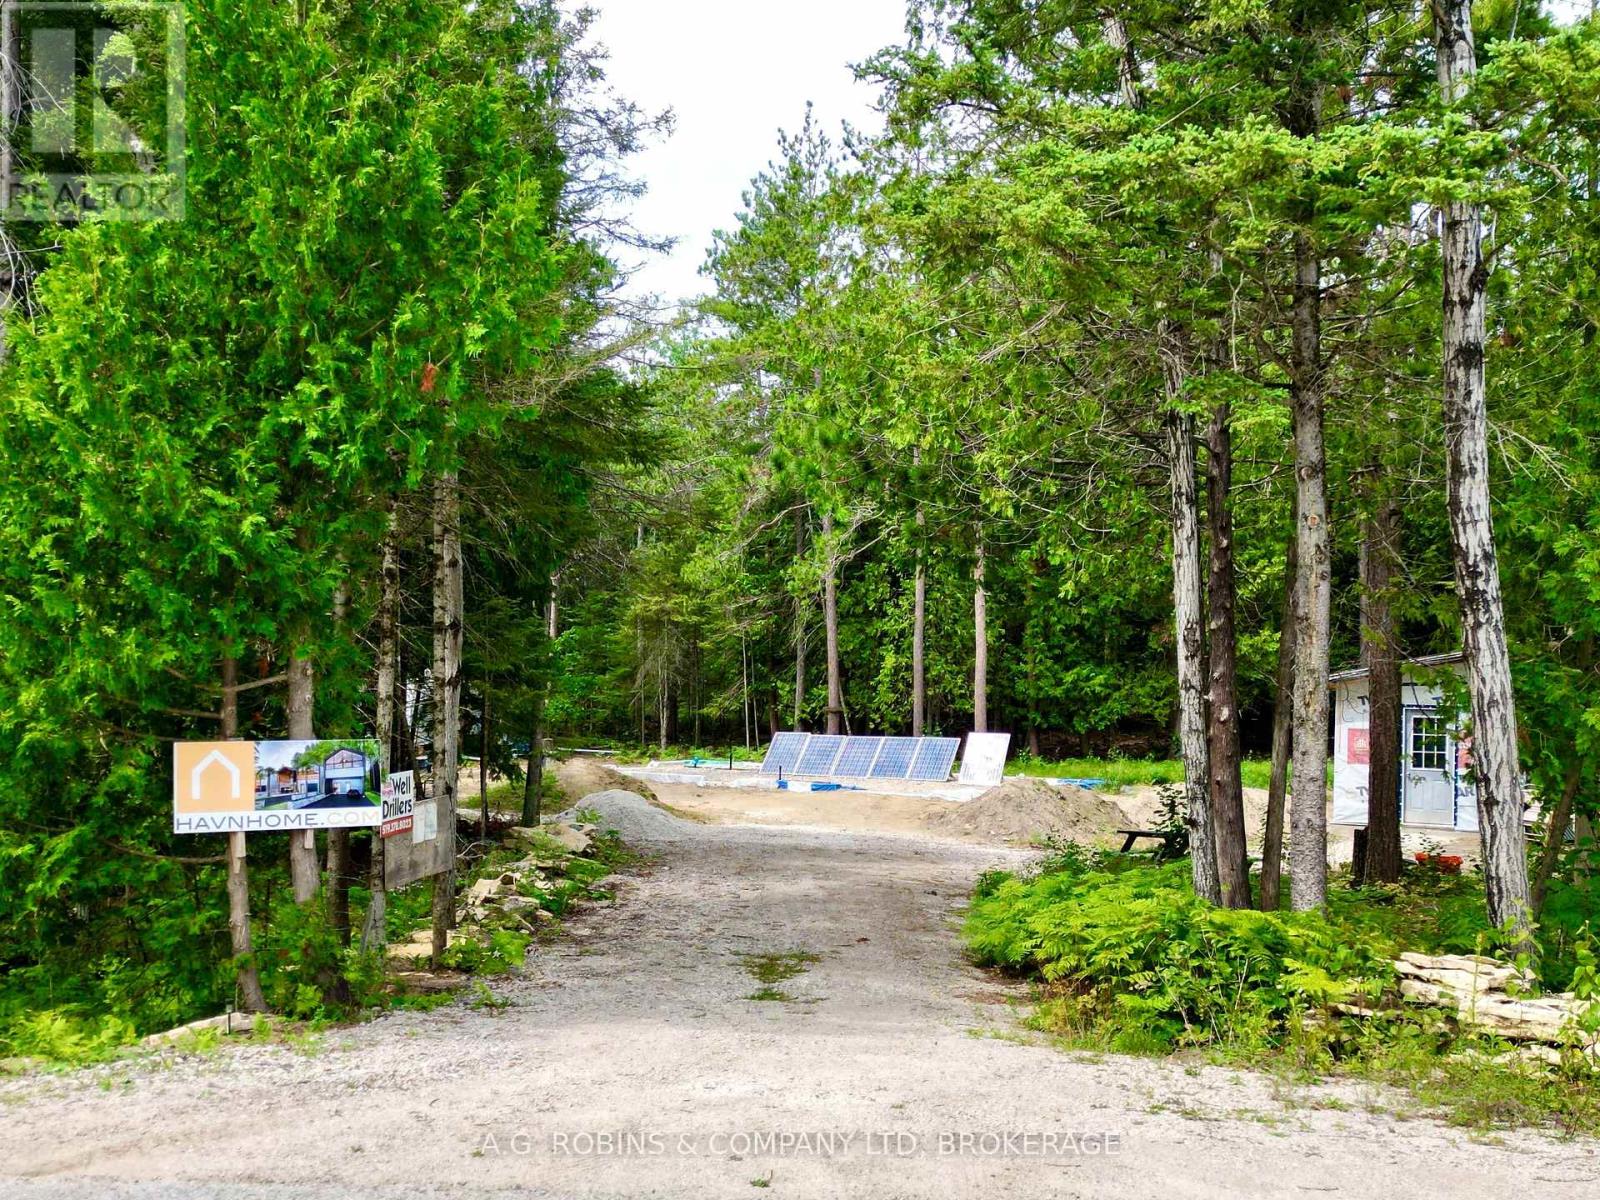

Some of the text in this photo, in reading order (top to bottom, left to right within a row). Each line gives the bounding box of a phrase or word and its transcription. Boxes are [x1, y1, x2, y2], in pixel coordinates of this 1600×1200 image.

[390, 776, 411, 795] Well
[382, 797, 413, 819] Drillers
[176, 811, 380, 831] HAVNHOME.COM
